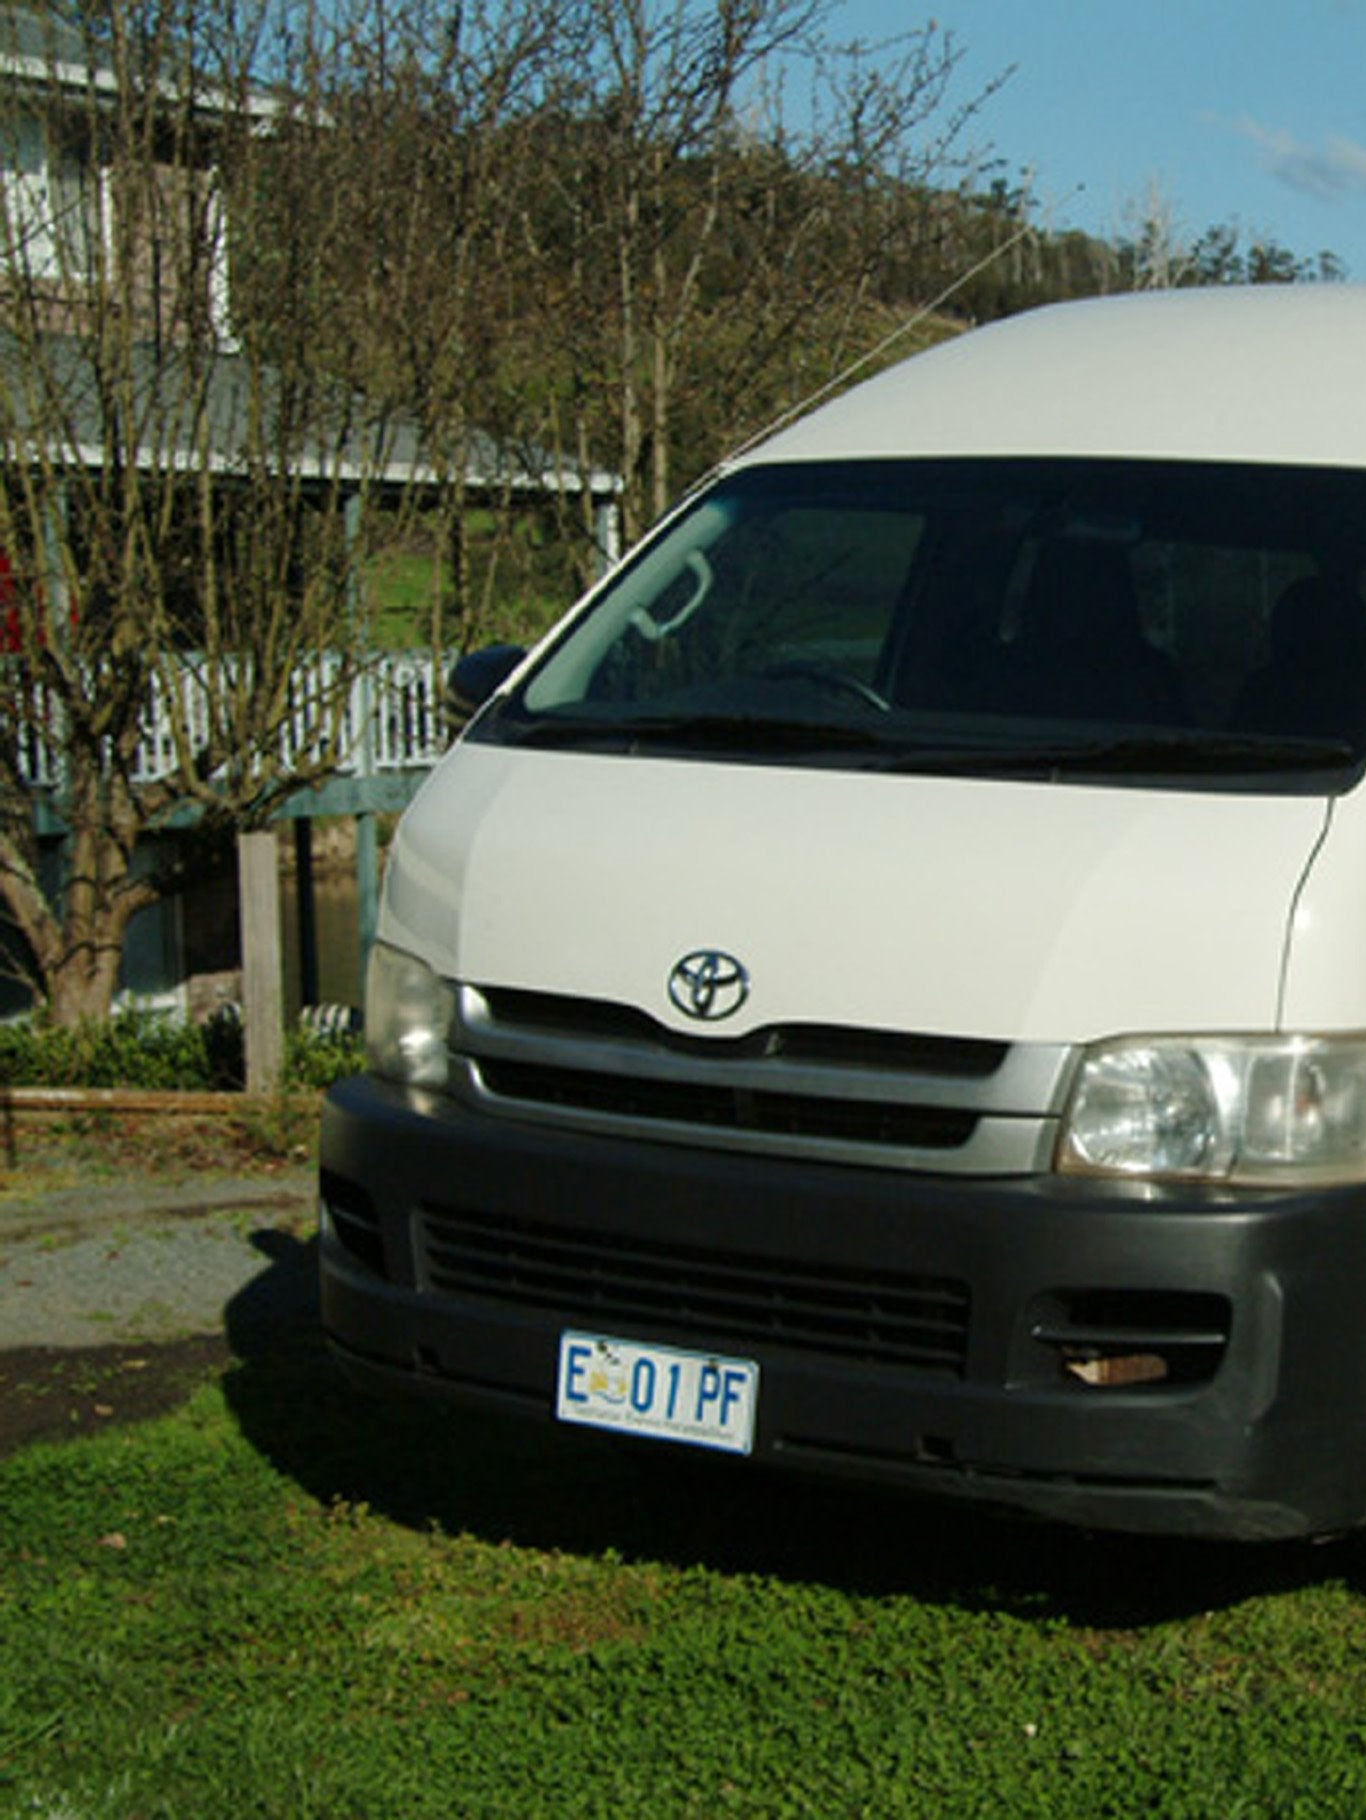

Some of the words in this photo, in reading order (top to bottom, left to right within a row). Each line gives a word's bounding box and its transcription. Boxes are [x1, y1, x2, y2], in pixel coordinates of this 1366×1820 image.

[566, 1346, 591, 1402] E
[632, 1358, 681, 1420] 01
[696, 1365, 747, 1426] PF
